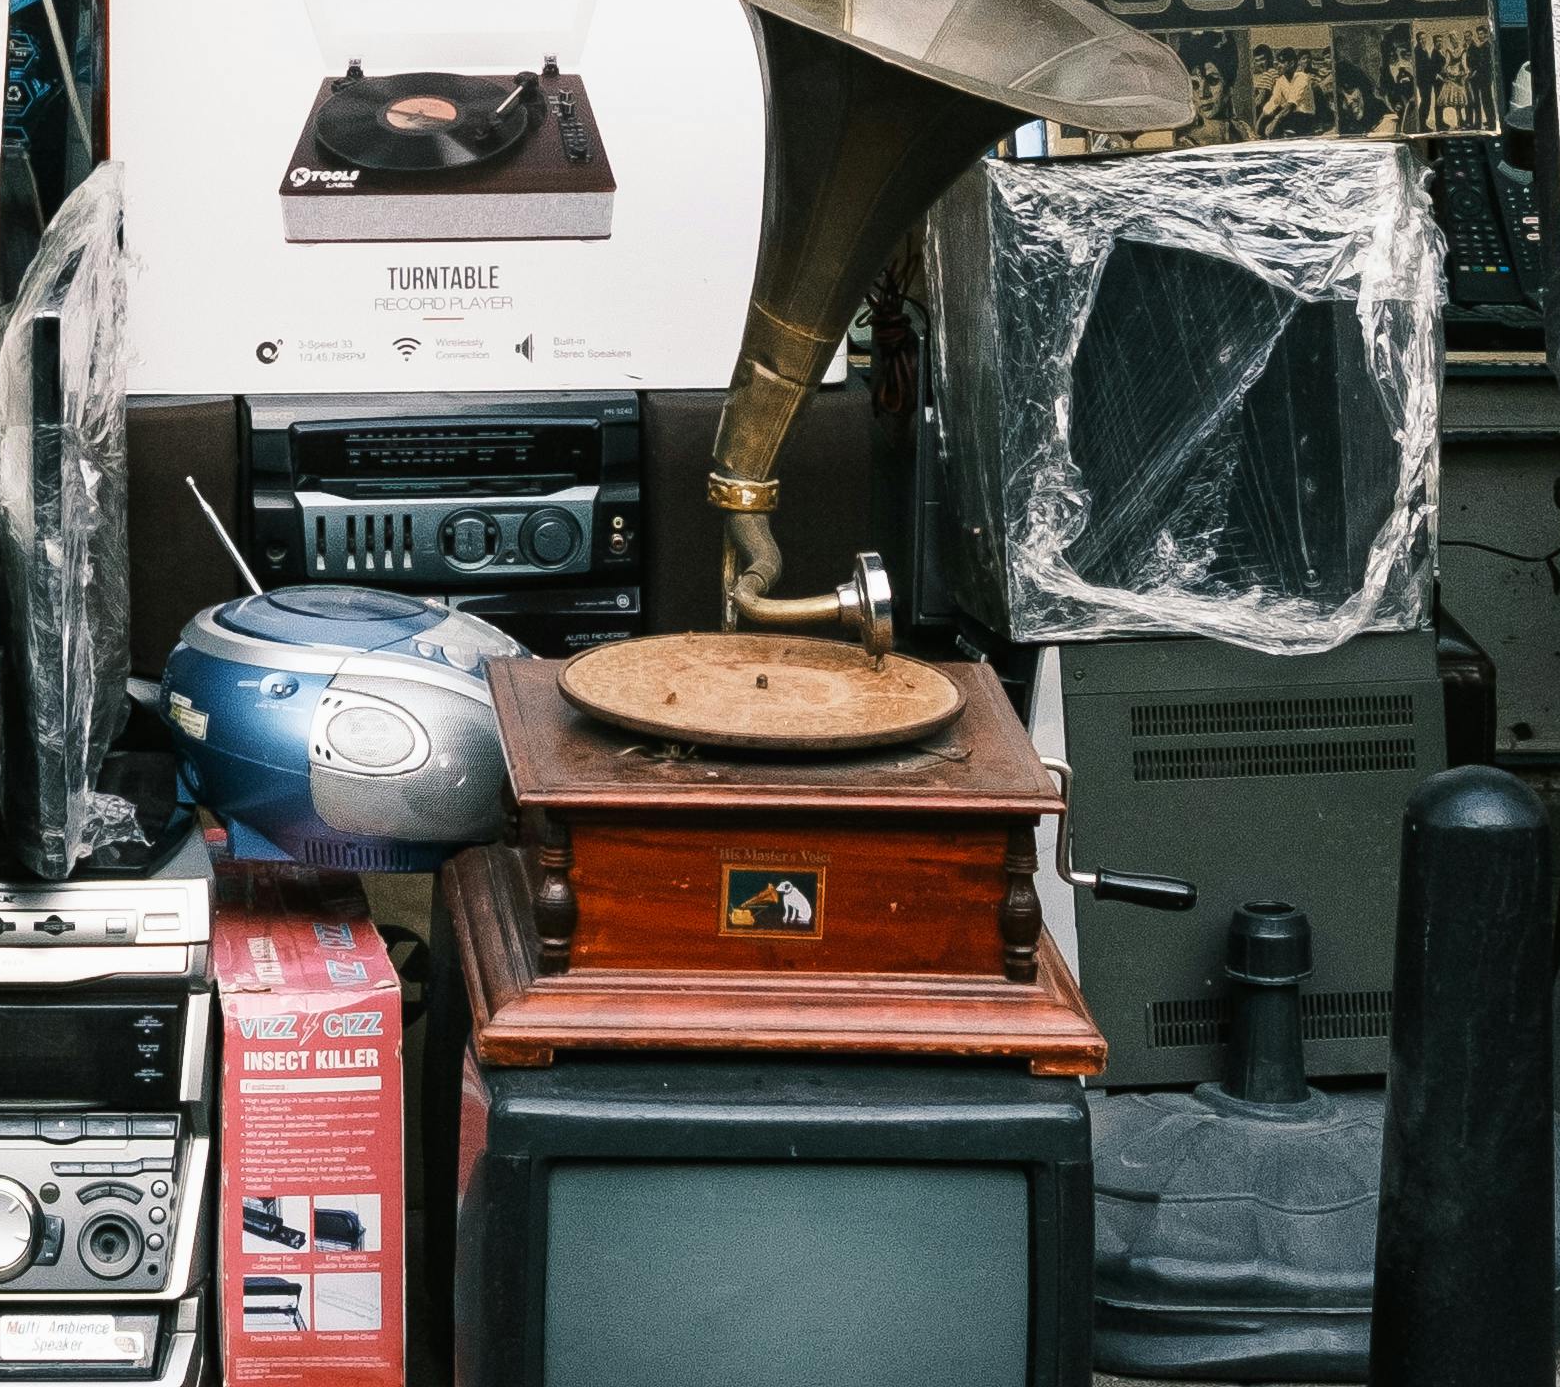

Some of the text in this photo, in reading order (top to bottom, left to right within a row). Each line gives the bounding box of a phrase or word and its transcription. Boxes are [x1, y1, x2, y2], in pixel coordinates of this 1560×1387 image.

[386, 264, 501, 291] TURNTABLE
[373, 295, 514, 312] RECORD PLAYER
[239, 1011, 384, 1040] VIZZ CIZZ
[242, 1047, 380, 1072] INSECT KILLER
[48, 1319, 112, 1335] Ambience
[31, 1335, 84, 1354] Speaker
